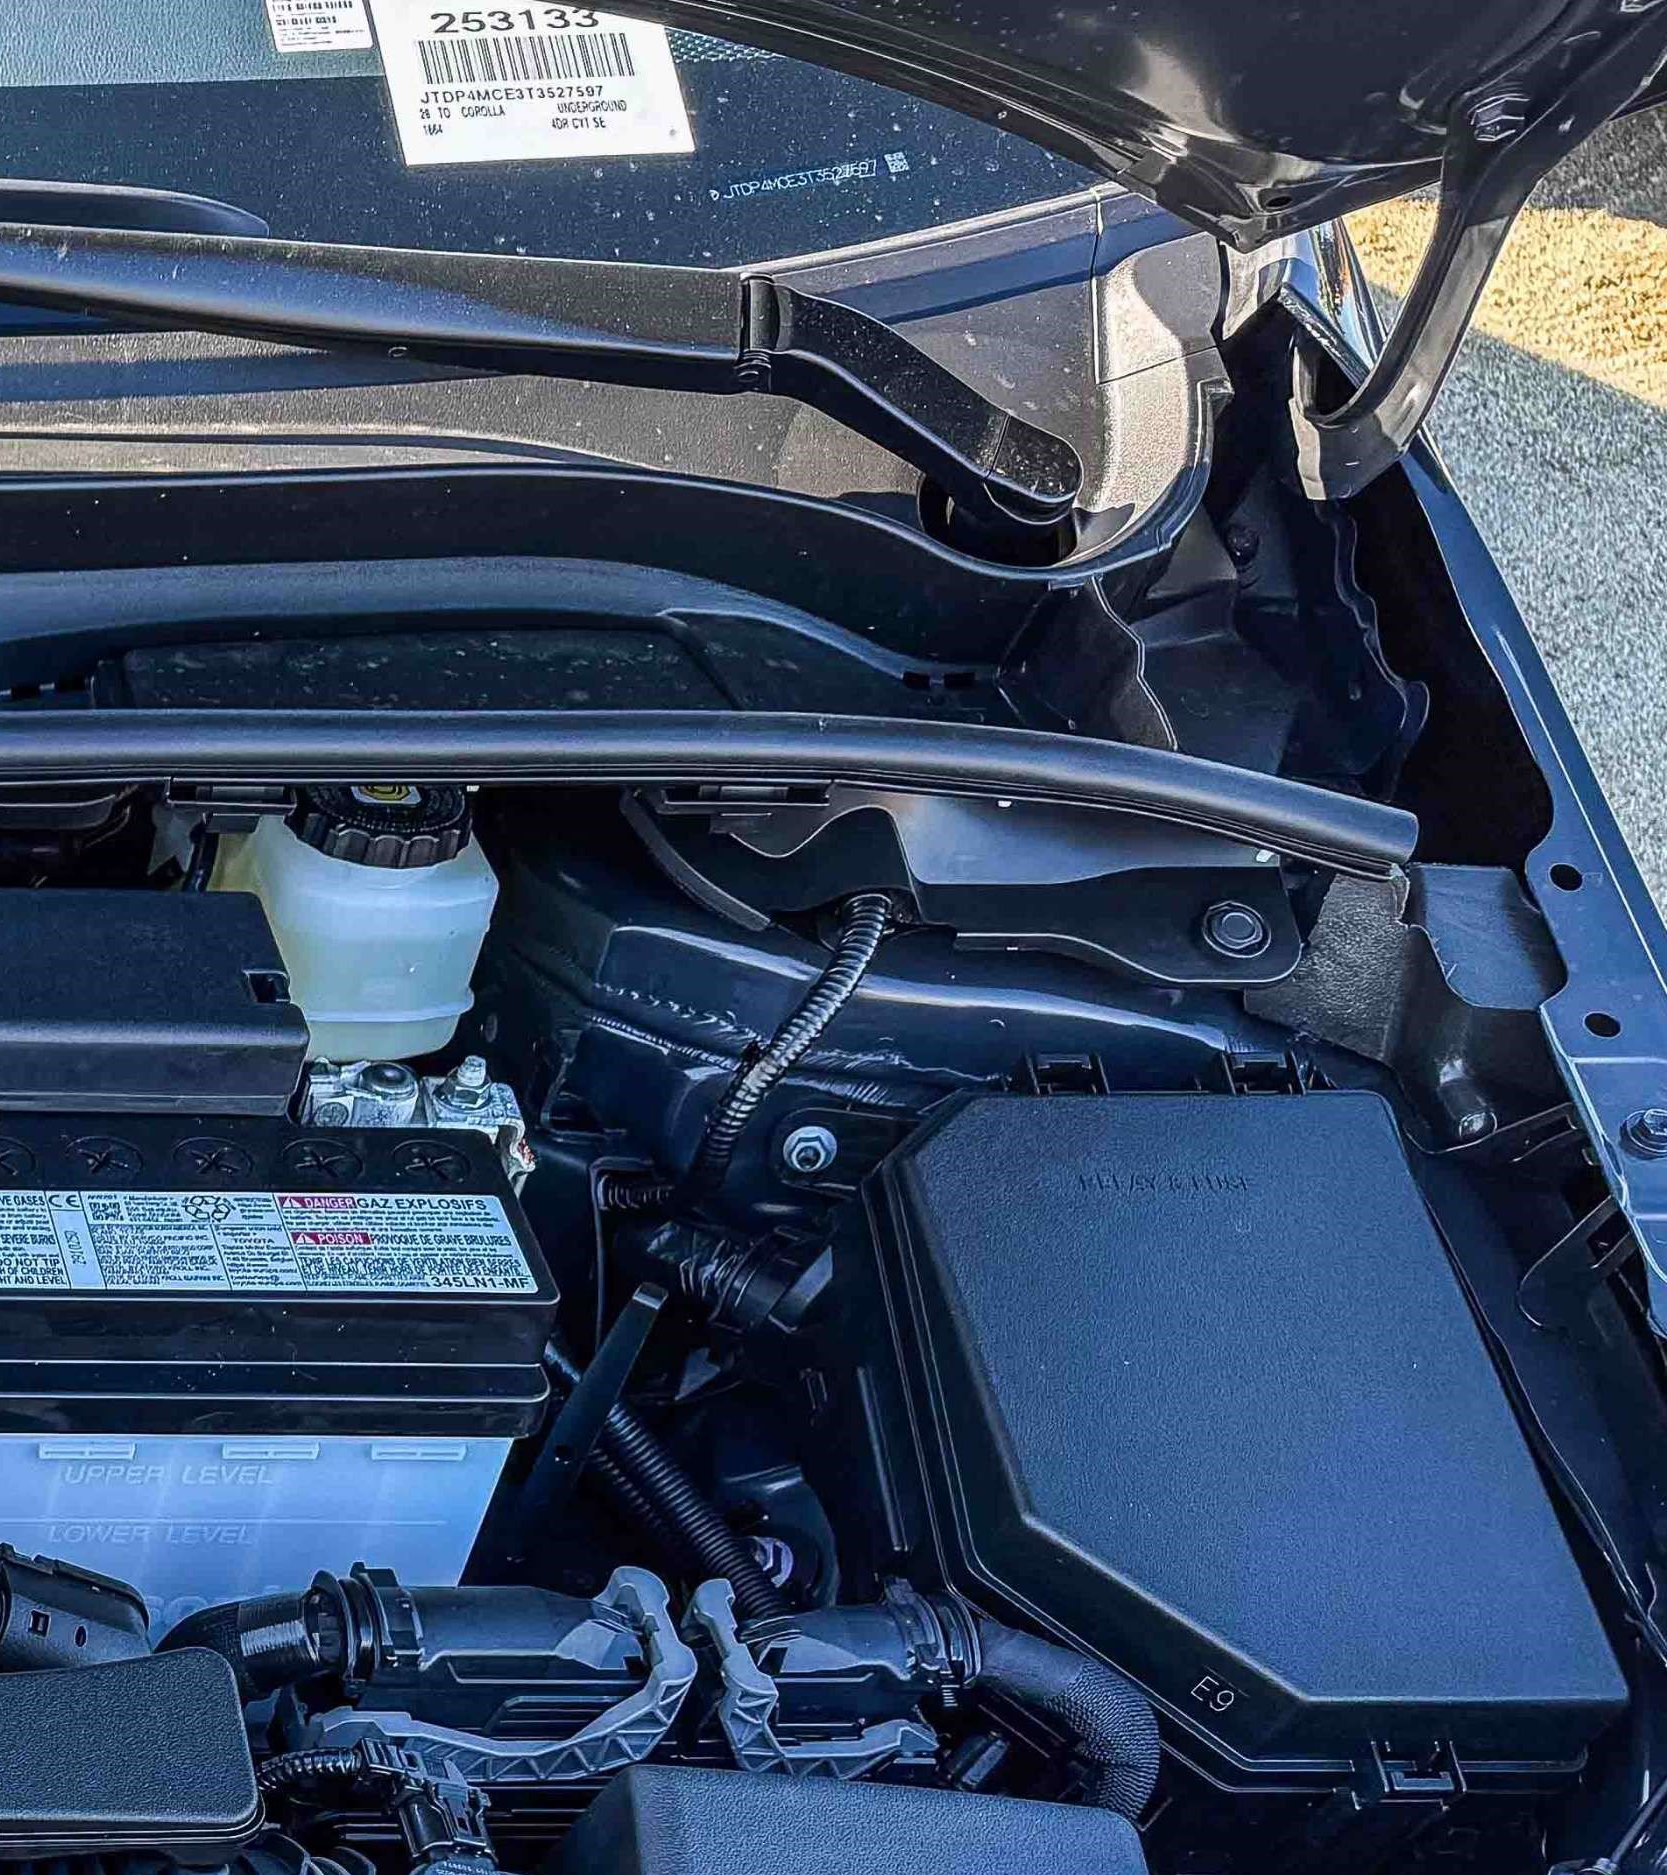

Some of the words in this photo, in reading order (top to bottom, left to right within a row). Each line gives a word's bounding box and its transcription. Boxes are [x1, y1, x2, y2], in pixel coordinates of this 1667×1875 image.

[430, 8, 600, 34] 253133
[420, 85, 603, 104] JTDP4MCE3T3527597
[461, 105, 505, 118] COROLLA
[13, 1195, 46, 1206] GASES
[304, 1197, 356, 1208] DANGER
[357, 1198, 392, 1209] GAZ
[397, 1199, 487, 1210] EXPLOSIFS
[2, 1234, 30, 1245] SEVERE
[317, 1233, 364, 1244] POISON
[370, 1234, 418, 1245] PROVOQUE
[420, 1235, 432, 1245] DE
[17, 1258, 39, 1266] NOT
[43, 1258, 60, 1266] TIP
[7, 1267, 18, 1275] OF
[20, 1267, 64, 1275] CHILDREN
[14, 1276, 40, 1285] AND
[42, 1276, 67, 1285] LEVEL
[431, 1276, 530, 1289] 345LN1-MF
[66, 1465, 166, 1485] UPPER
[182, 1465, 274, 1485] LEVEL
[48, 1525, 152, 1545] LOWER
[169, 1525, 254, 1545] LEVEL
[1190, 1675, 1235, 1712] E9
